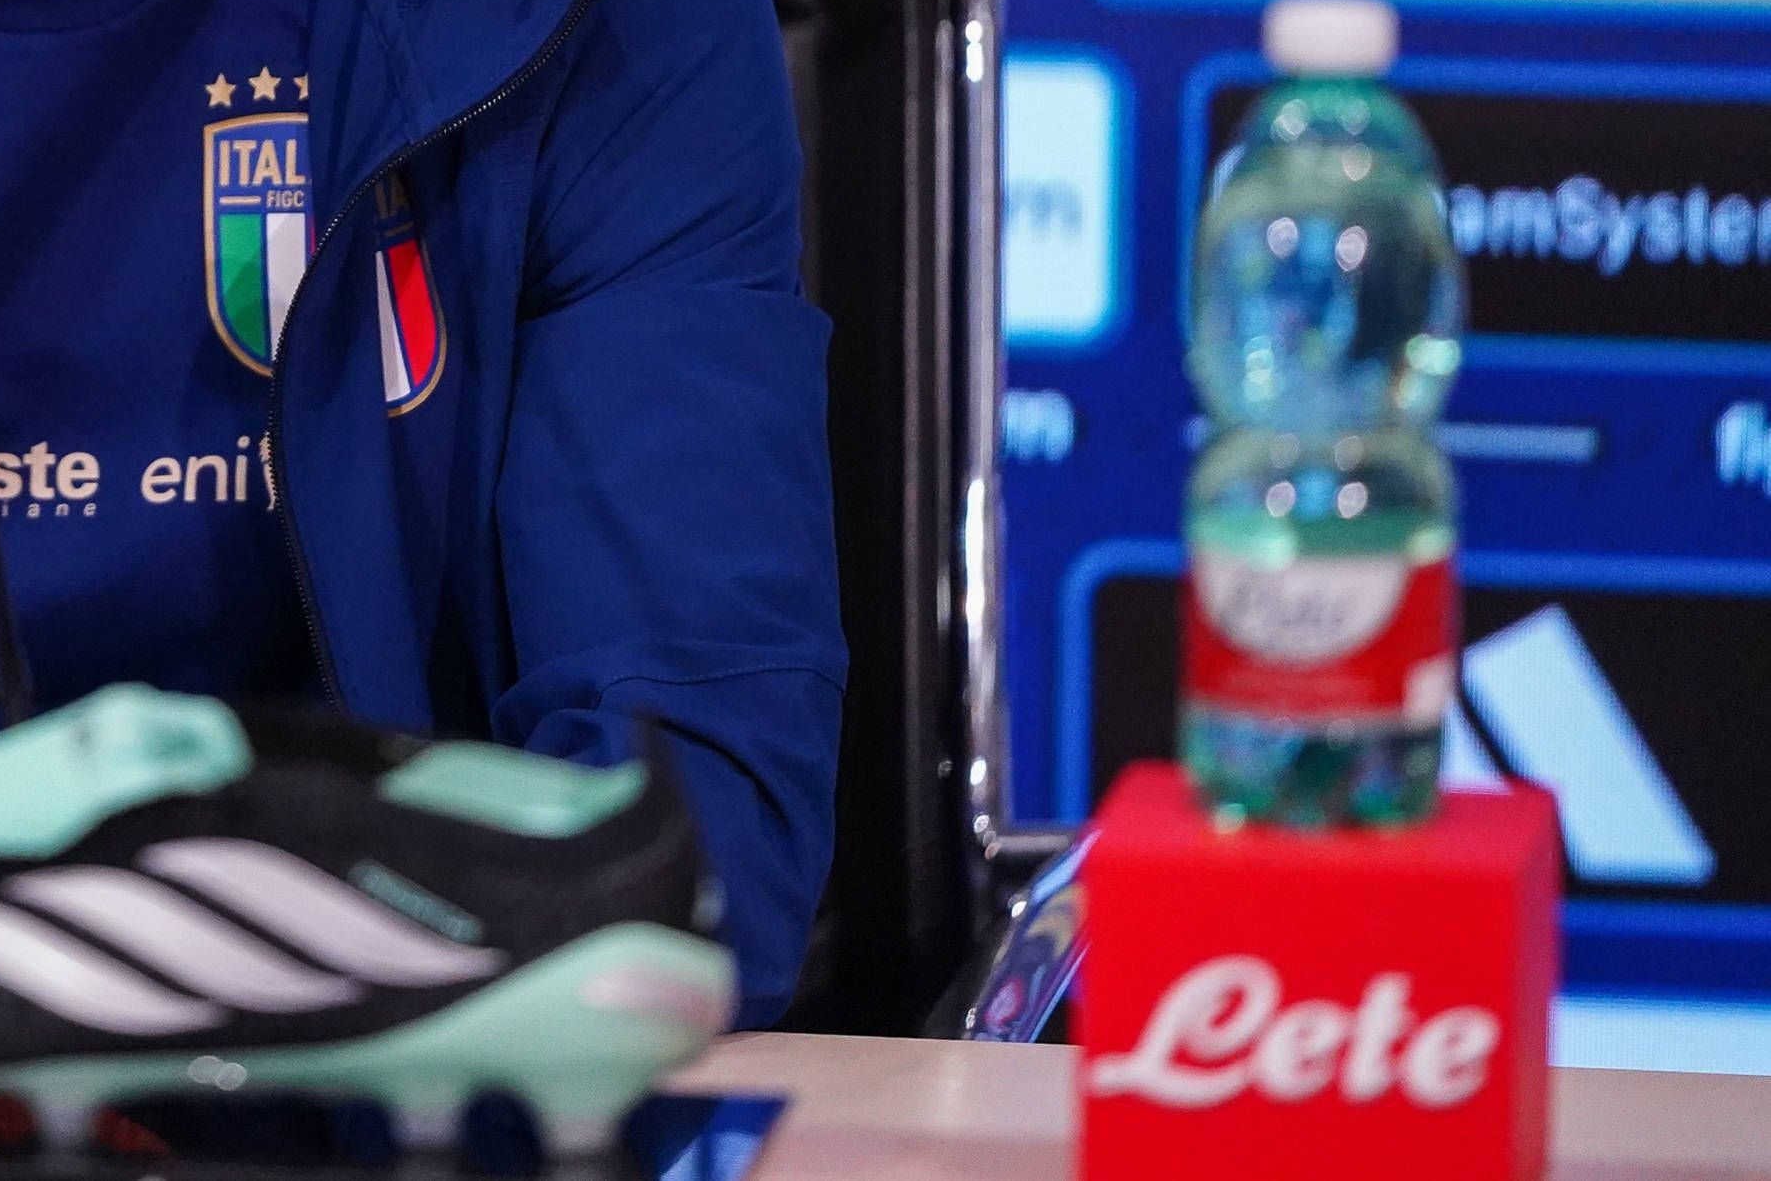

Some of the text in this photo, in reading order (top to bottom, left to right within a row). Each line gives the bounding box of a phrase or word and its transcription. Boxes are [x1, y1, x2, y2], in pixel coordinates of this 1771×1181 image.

[219, 139, 308, 187] ITAL
[266, 190, 305, 207] FIGC
[1449, 174, 1771, 276] amSyste
[140, 436, 250, 503] eni
[1092, 954, 1501, 1108] Lete
